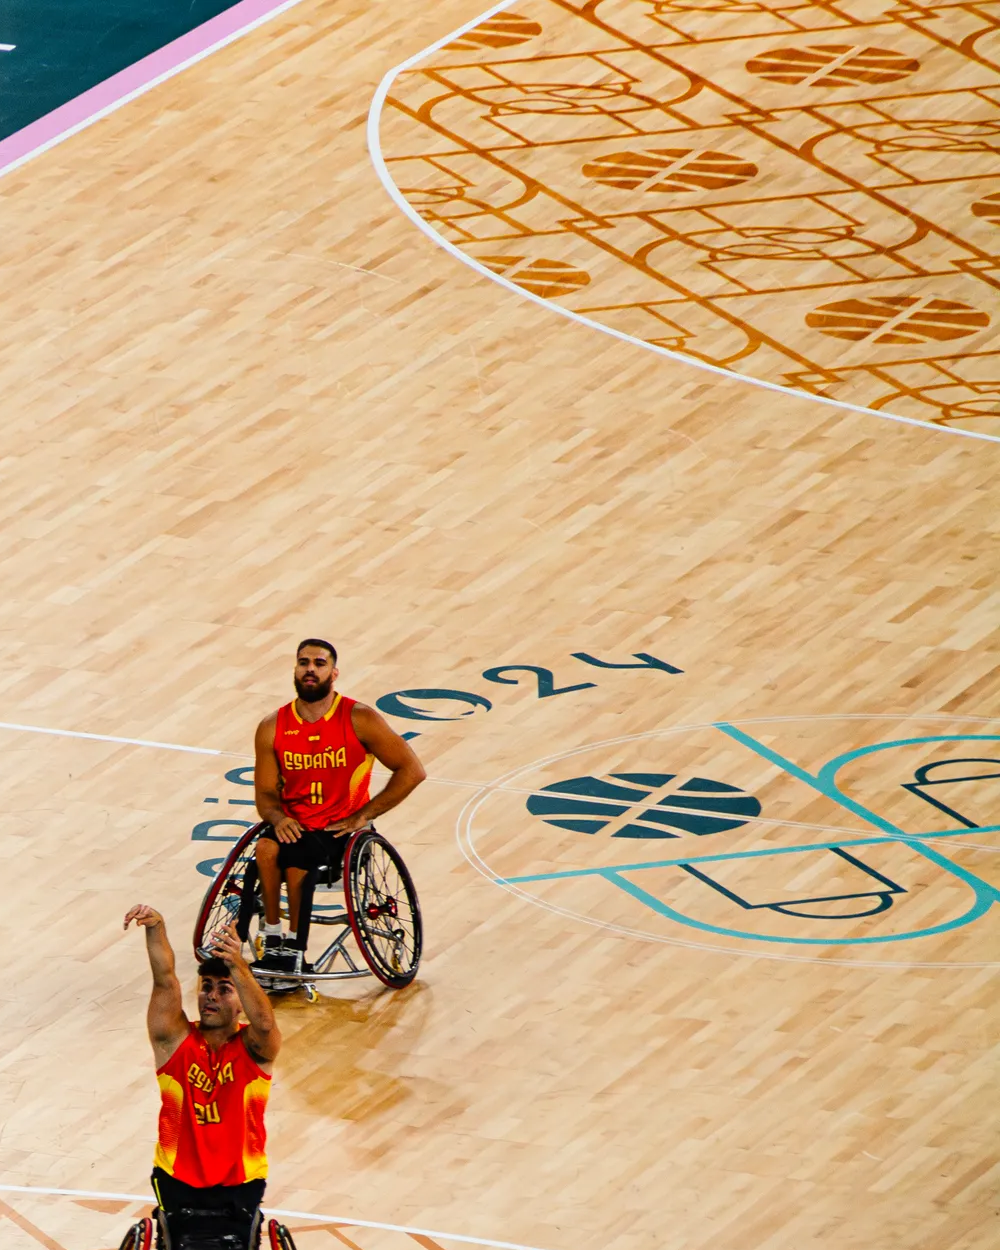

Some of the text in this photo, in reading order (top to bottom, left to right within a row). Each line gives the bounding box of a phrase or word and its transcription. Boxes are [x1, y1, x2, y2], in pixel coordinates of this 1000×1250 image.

[375, 652, 685, 742] 024
[283, 746, 347, 770] ESPAÑA
[310, 781, 323, 805] 11
